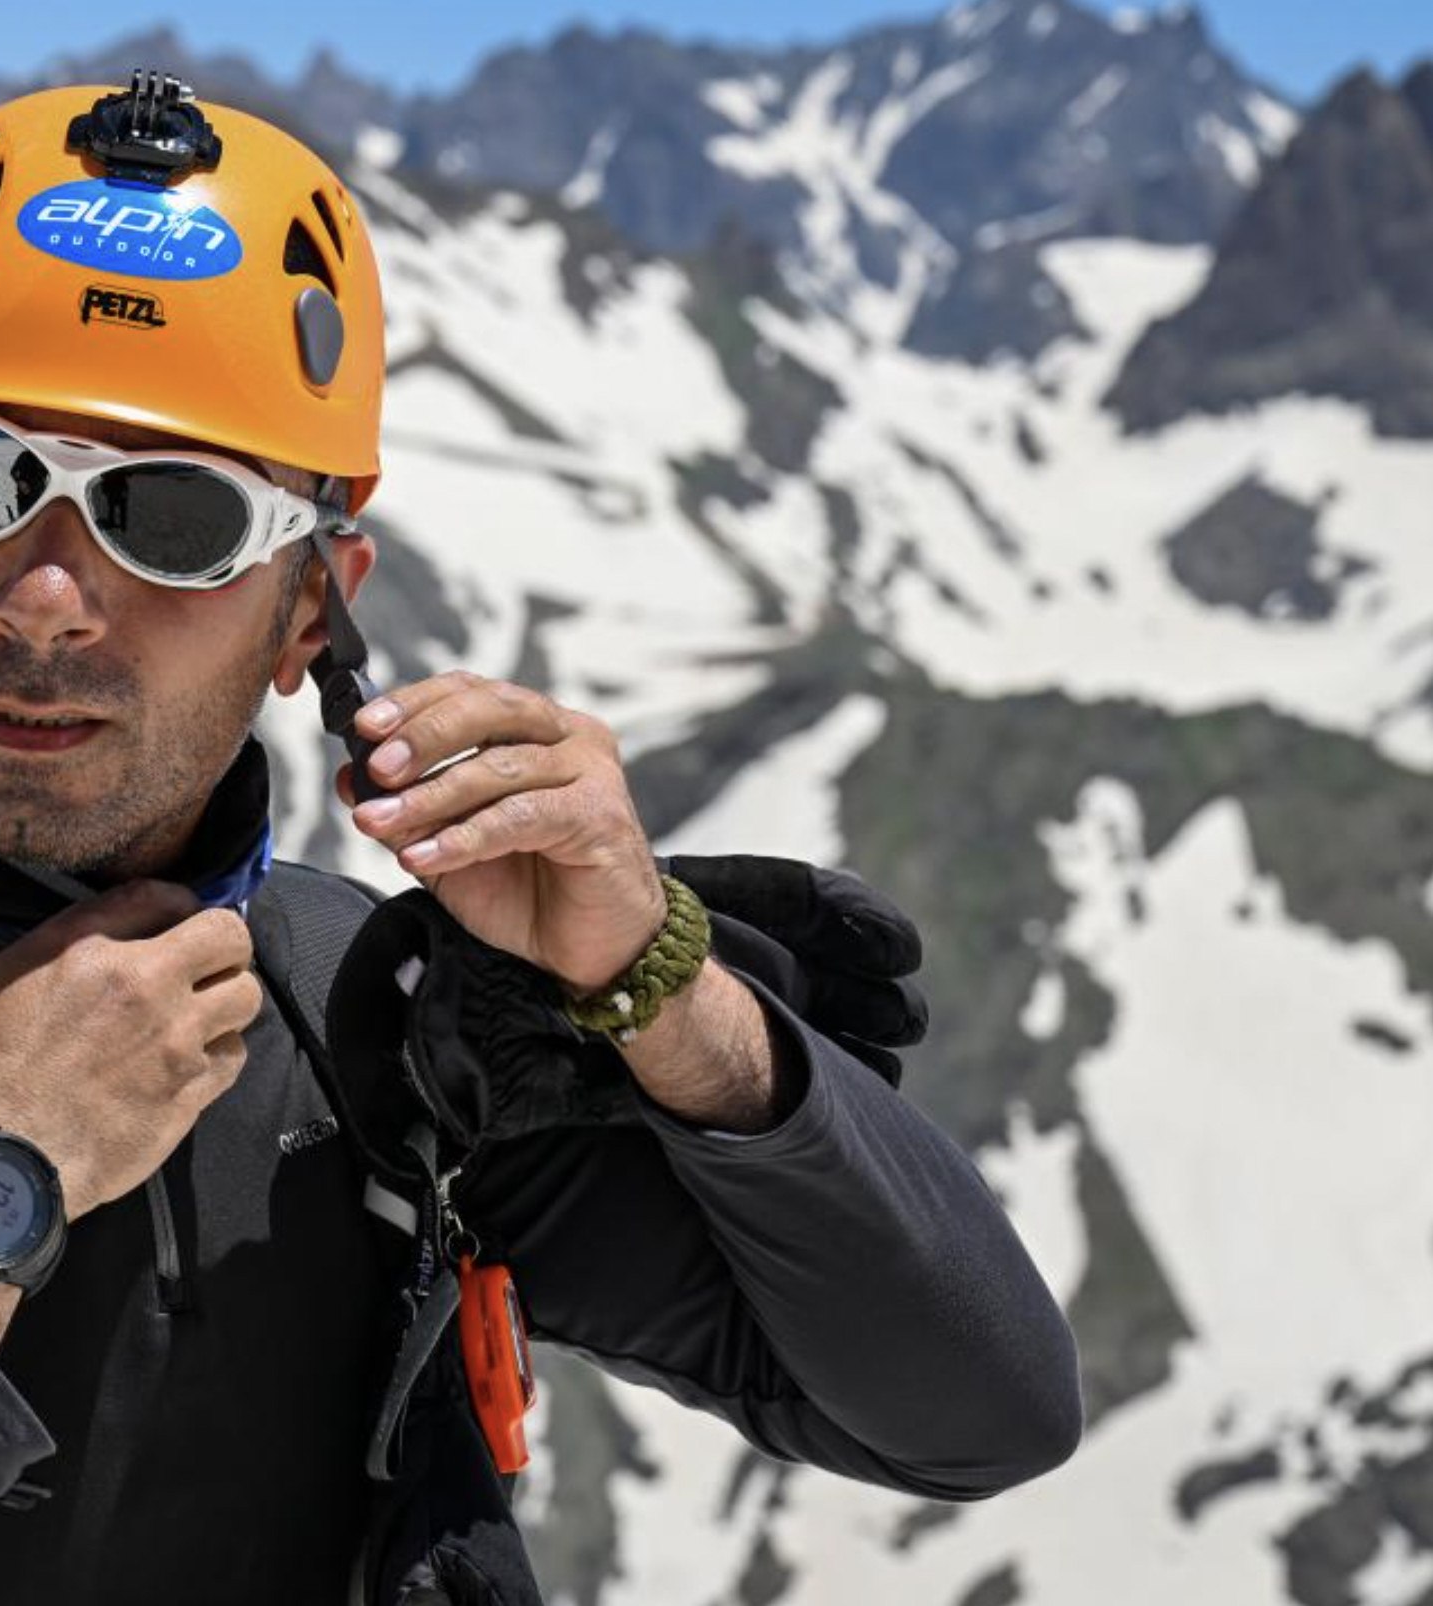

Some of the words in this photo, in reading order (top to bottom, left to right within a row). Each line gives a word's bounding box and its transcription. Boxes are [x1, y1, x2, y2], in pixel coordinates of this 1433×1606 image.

[36, 196, 226, 250] alpin
[50, 234, 196, 268] OUTDOOR
[80, 286, 167, 326] PETZL
